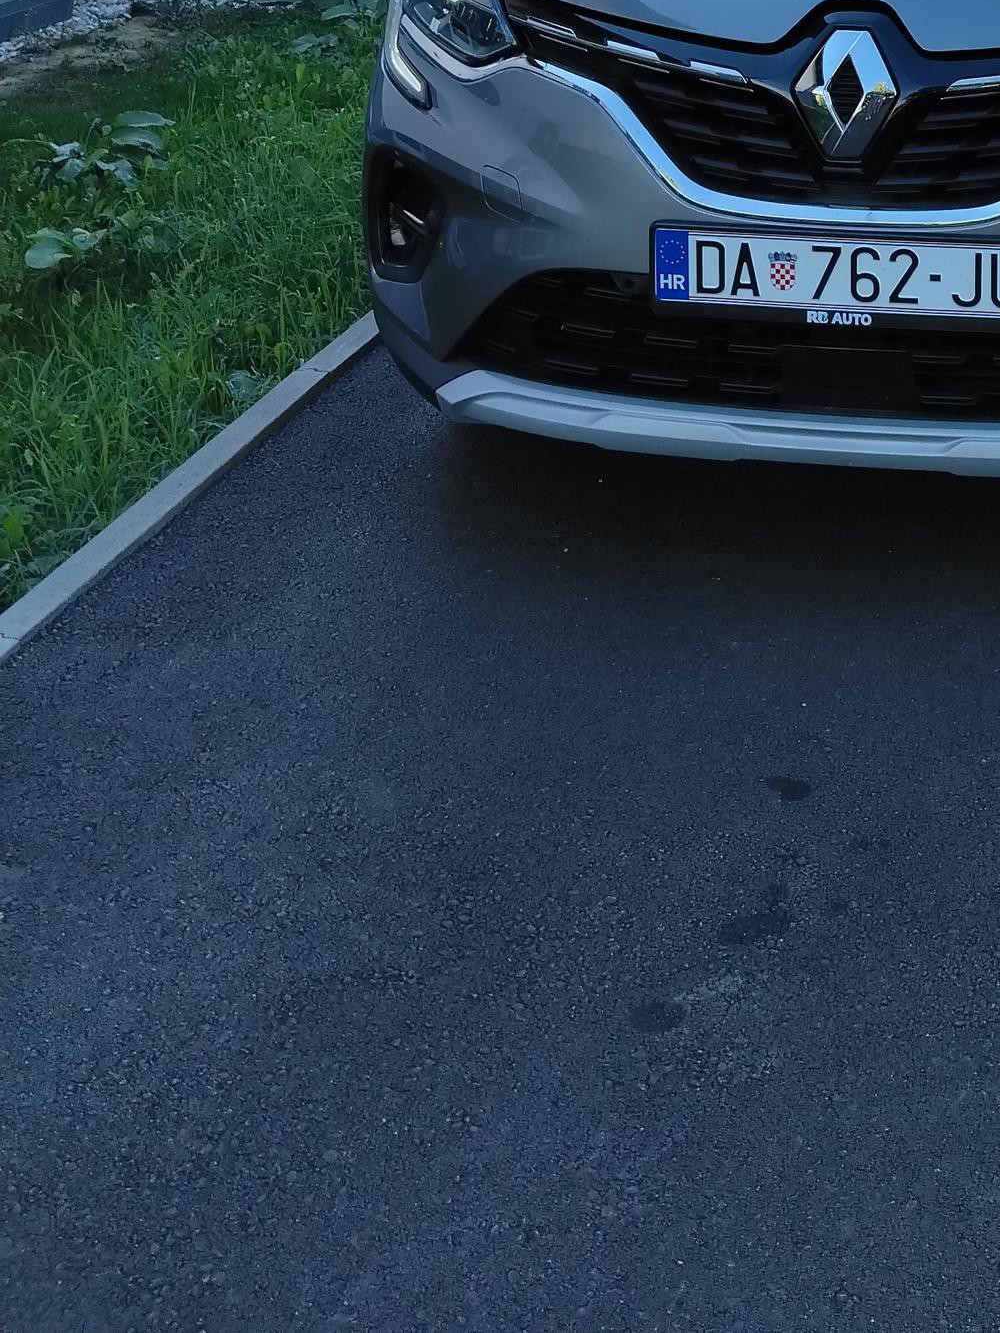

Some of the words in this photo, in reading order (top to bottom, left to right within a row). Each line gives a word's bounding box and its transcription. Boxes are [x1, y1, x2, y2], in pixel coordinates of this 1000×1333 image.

[696, 240, 760, 297] DA
[660, 273, 685, 290] HR
[831, 312, 873, 326] AUTO
